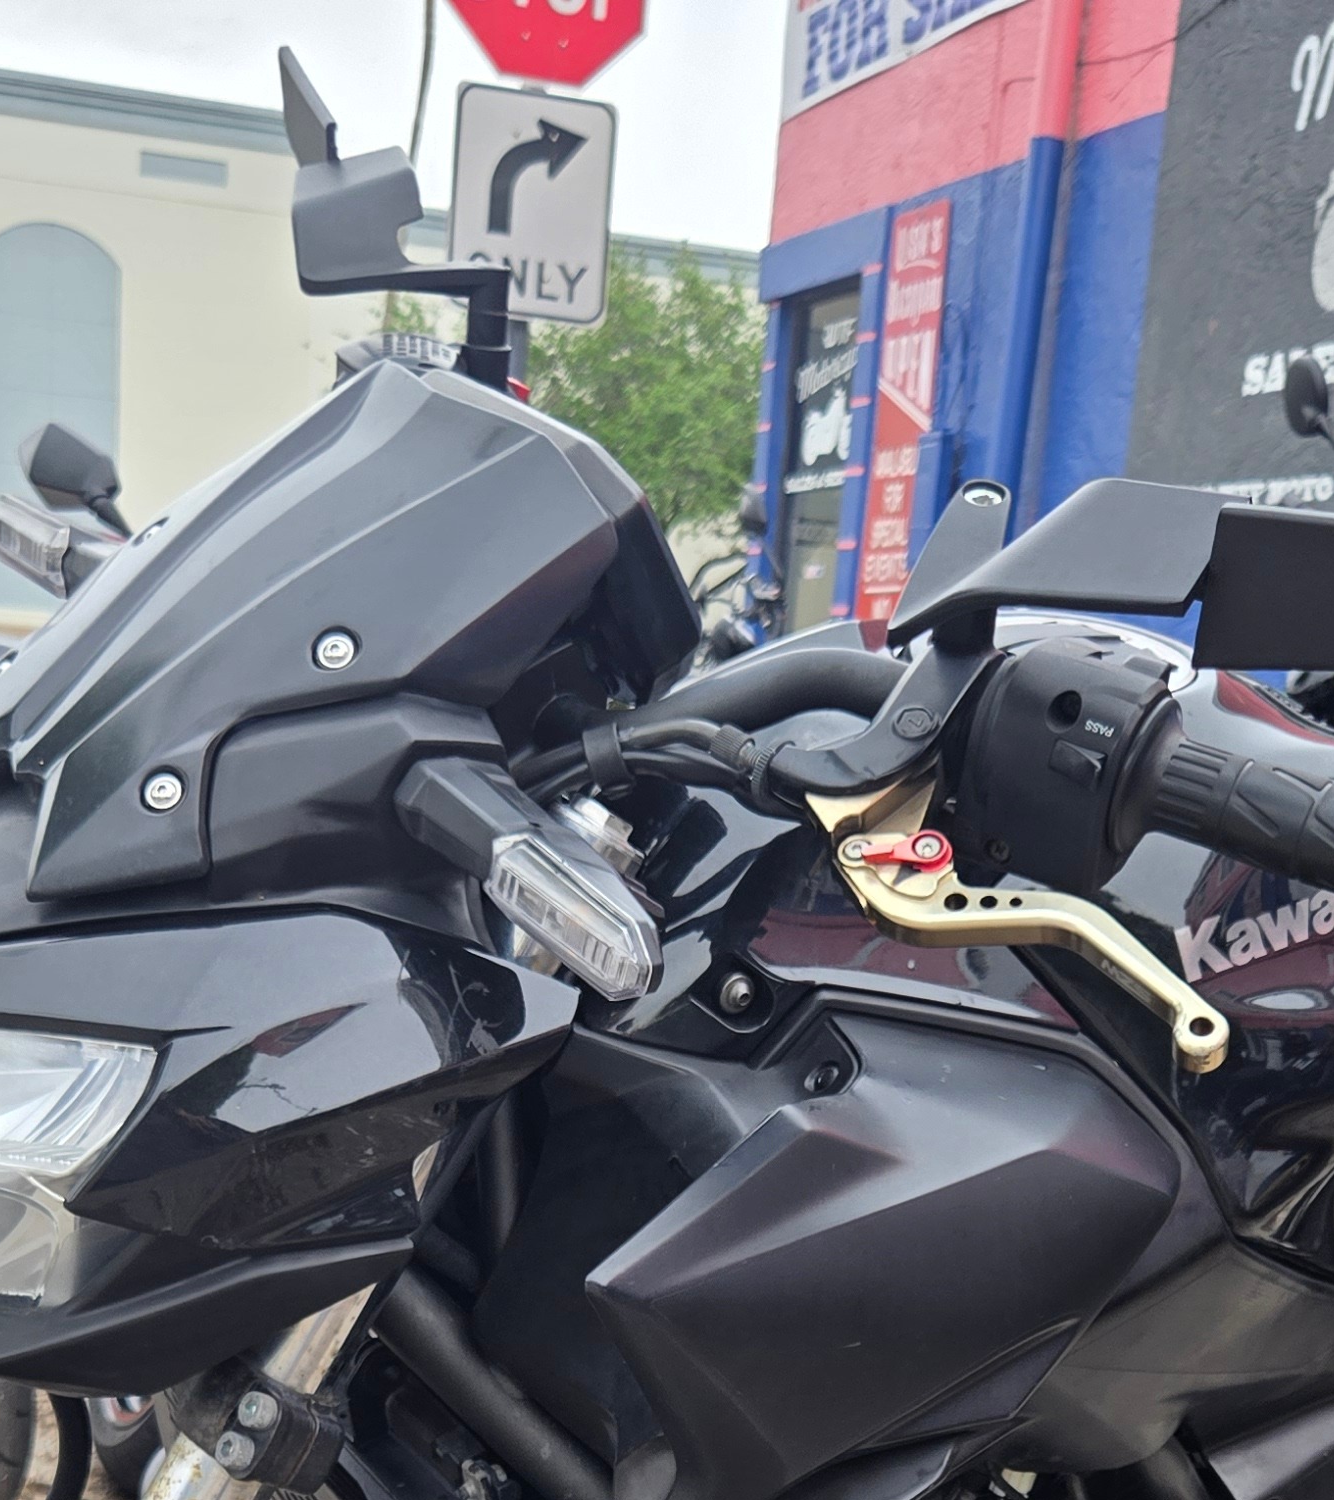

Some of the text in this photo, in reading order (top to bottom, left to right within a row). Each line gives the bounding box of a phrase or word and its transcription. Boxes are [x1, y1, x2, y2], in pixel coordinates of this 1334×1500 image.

[802, 0, 890, 98] FOR
[469, 251, 588, 304] NLY
[1084, 719, 1115, 738] PASS
